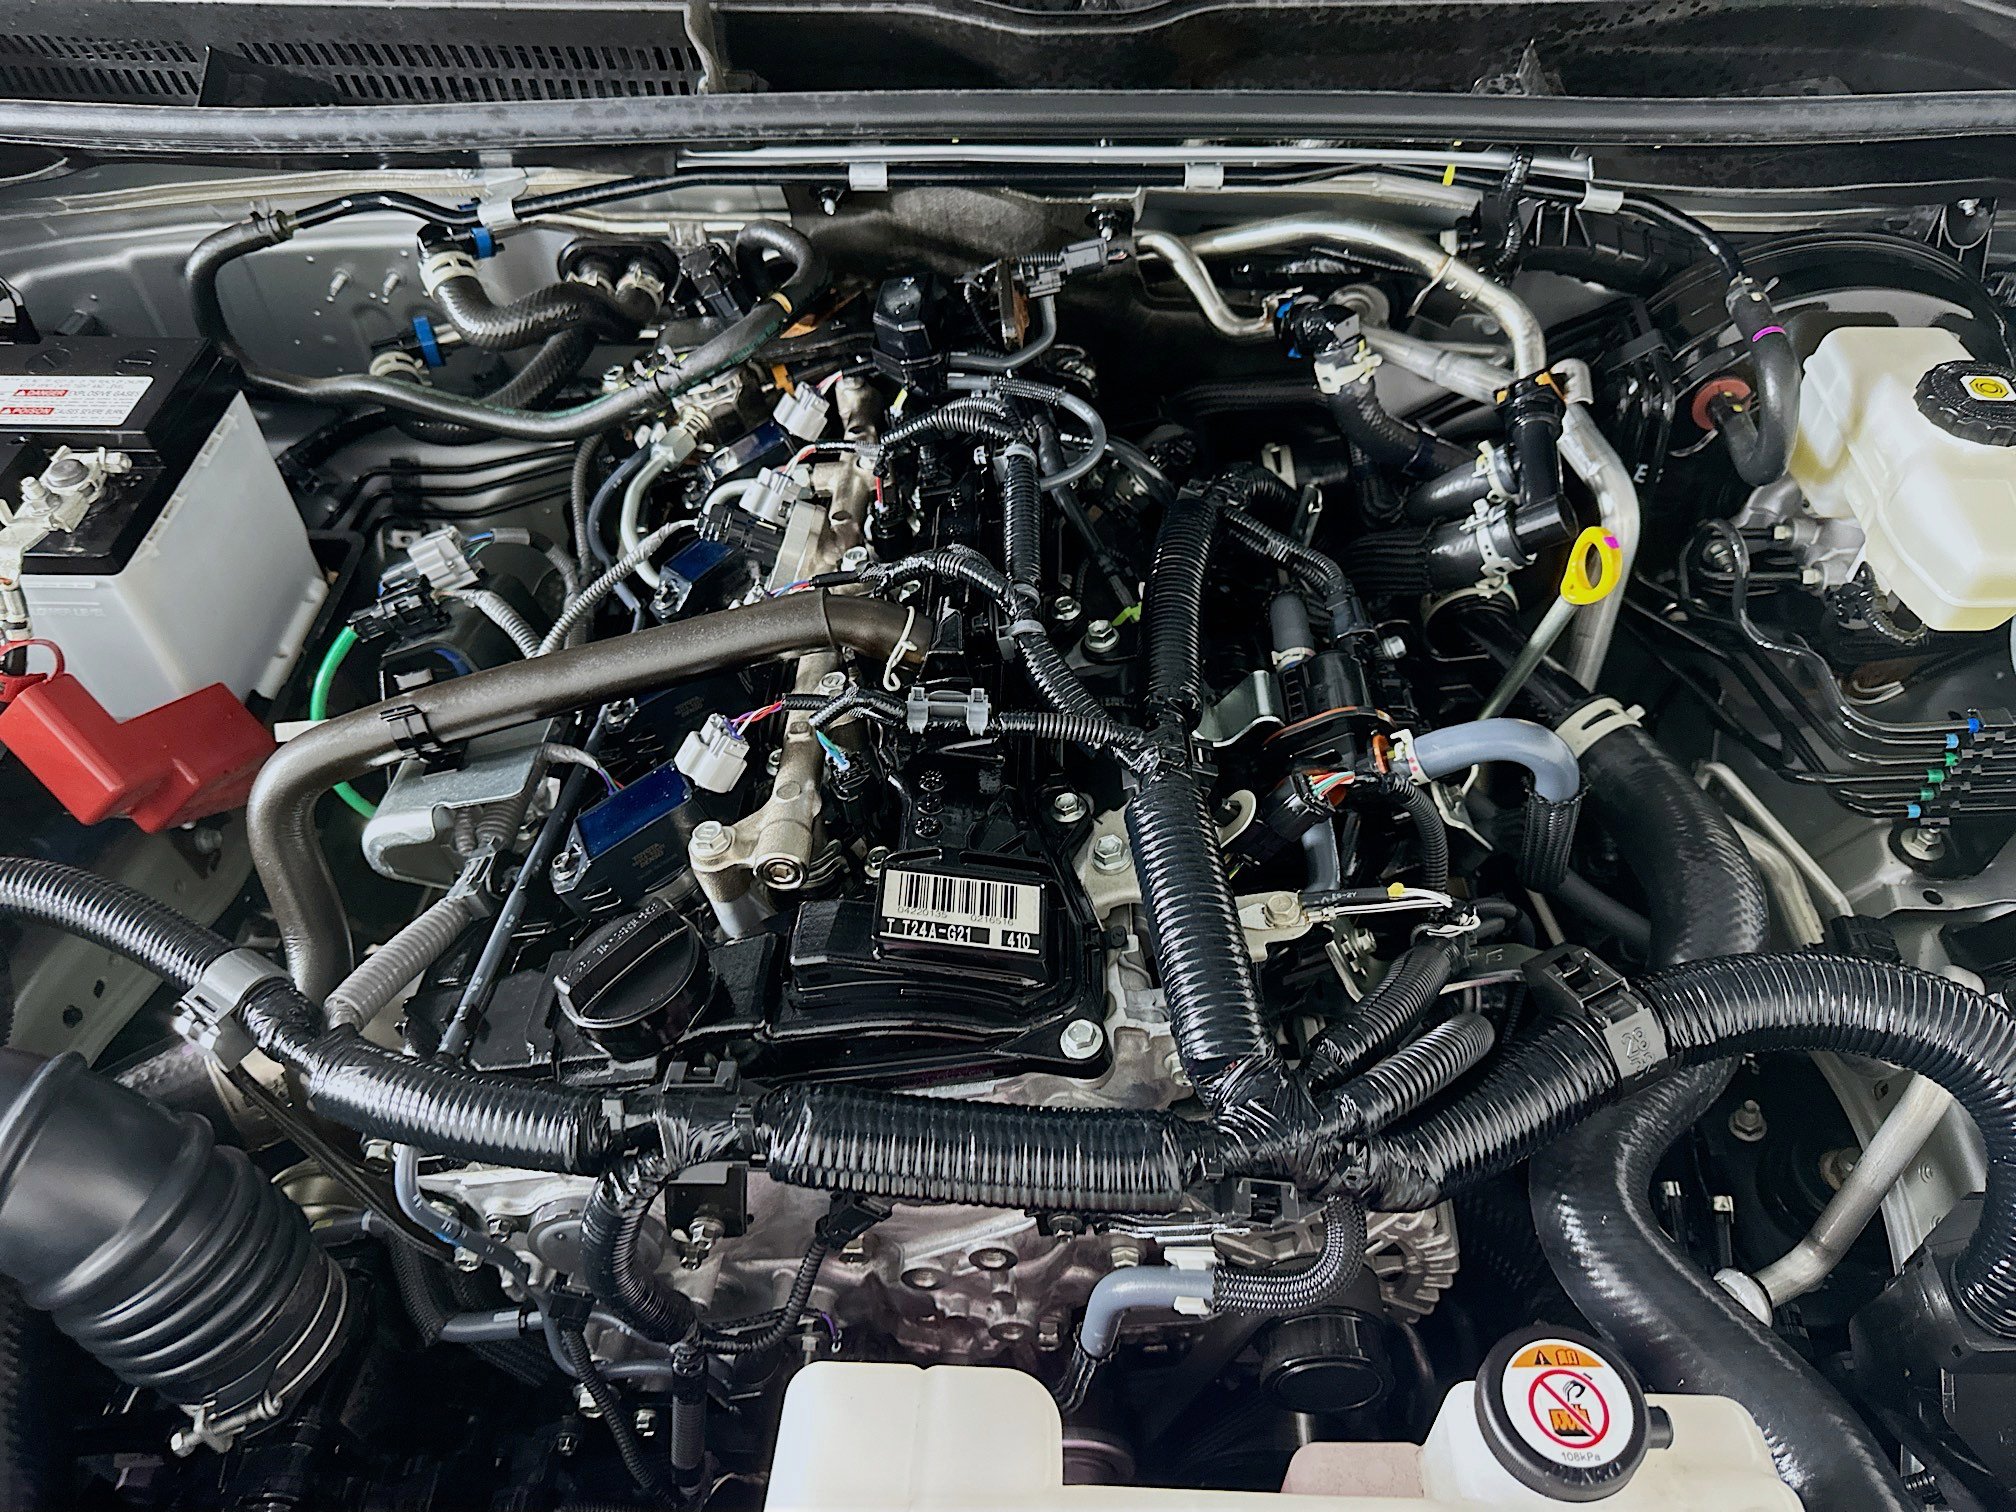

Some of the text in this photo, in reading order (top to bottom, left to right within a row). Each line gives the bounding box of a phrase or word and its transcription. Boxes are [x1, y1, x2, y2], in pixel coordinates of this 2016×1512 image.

[886, 918, 1031, 950] T T24A-G21 410
